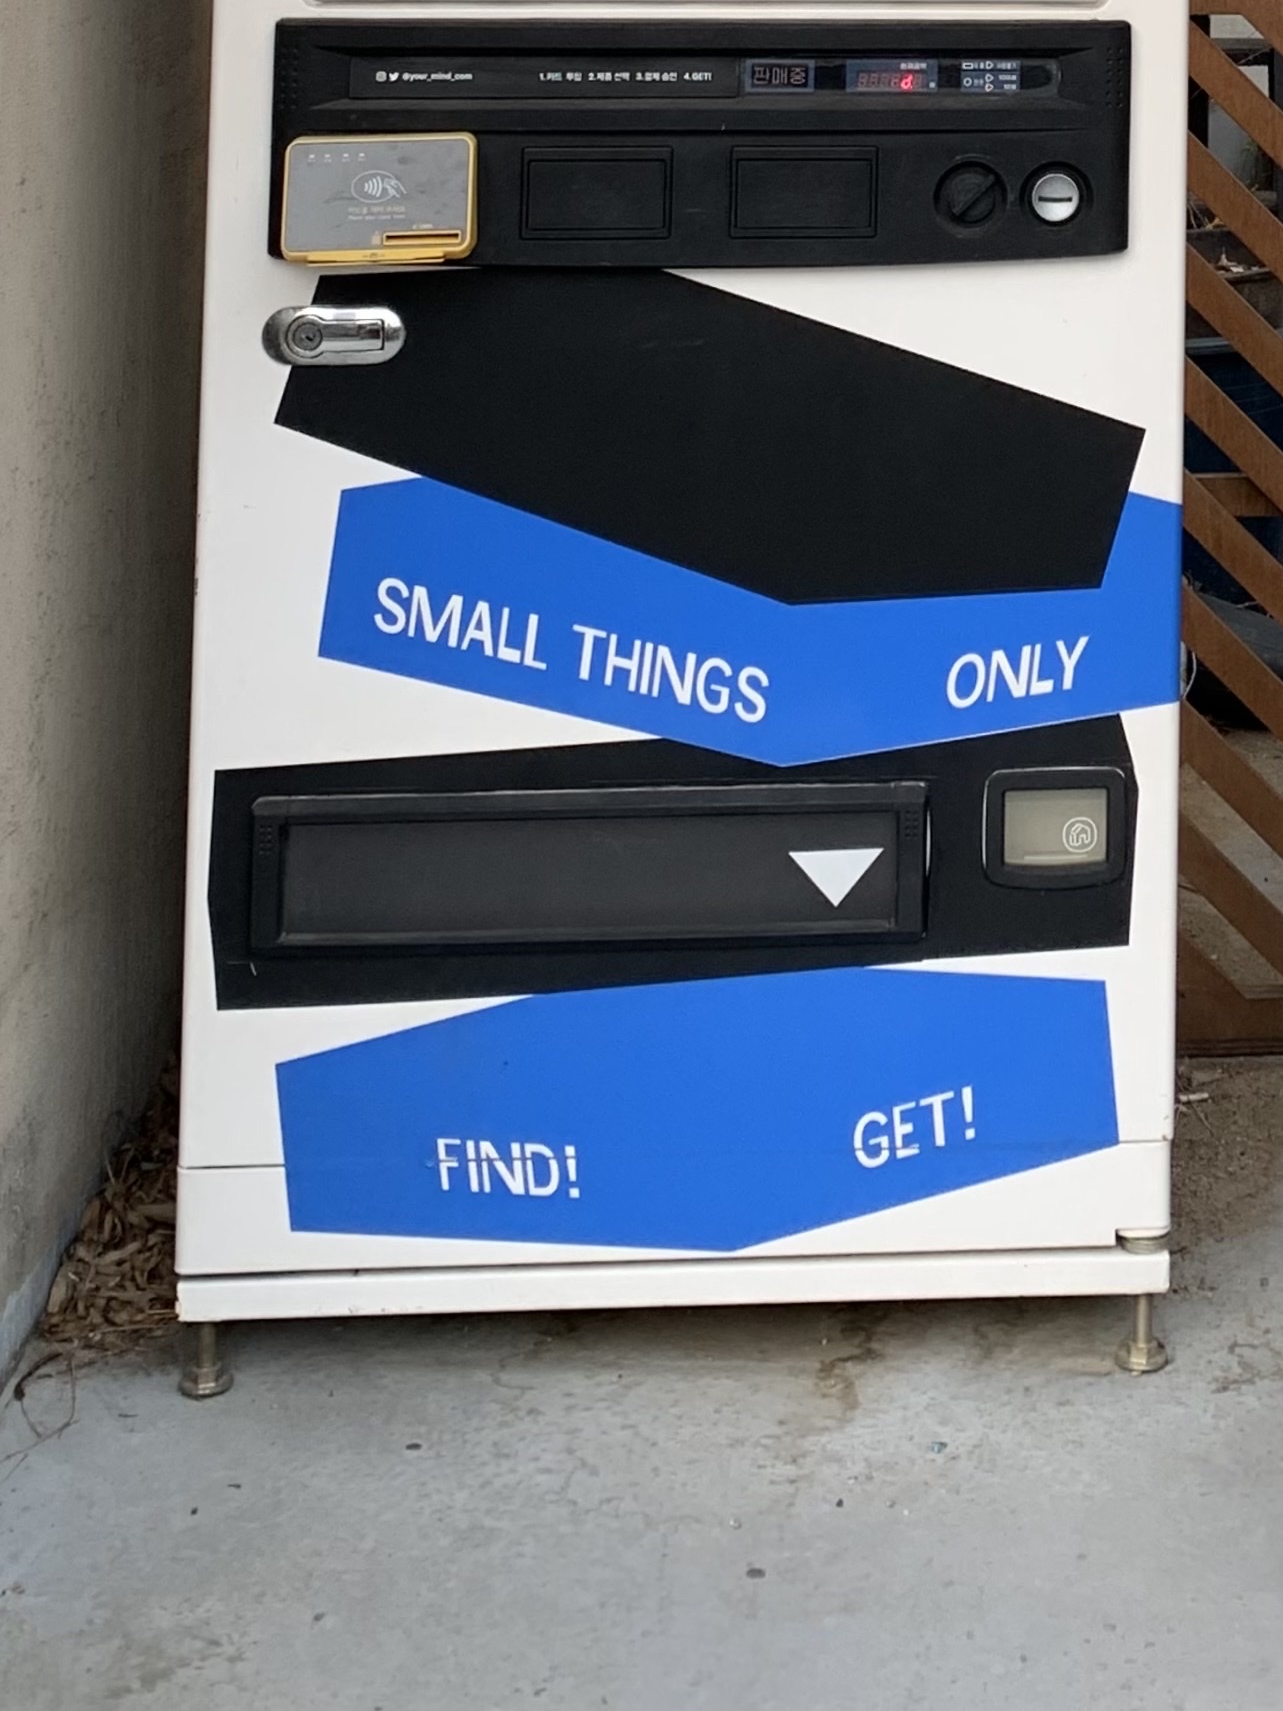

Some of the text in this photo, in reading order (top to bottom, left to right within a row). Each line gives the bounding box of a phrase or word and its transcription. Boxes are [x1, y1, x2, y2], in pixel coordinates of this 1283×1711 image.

[753, 66, 806, 85] 판매중
[374, 577, 1089, 723] SMALL THINGS ONLY
[853, 1085, 976, 1169] GET!
[435, 1138, 580, 1199] FIND!
